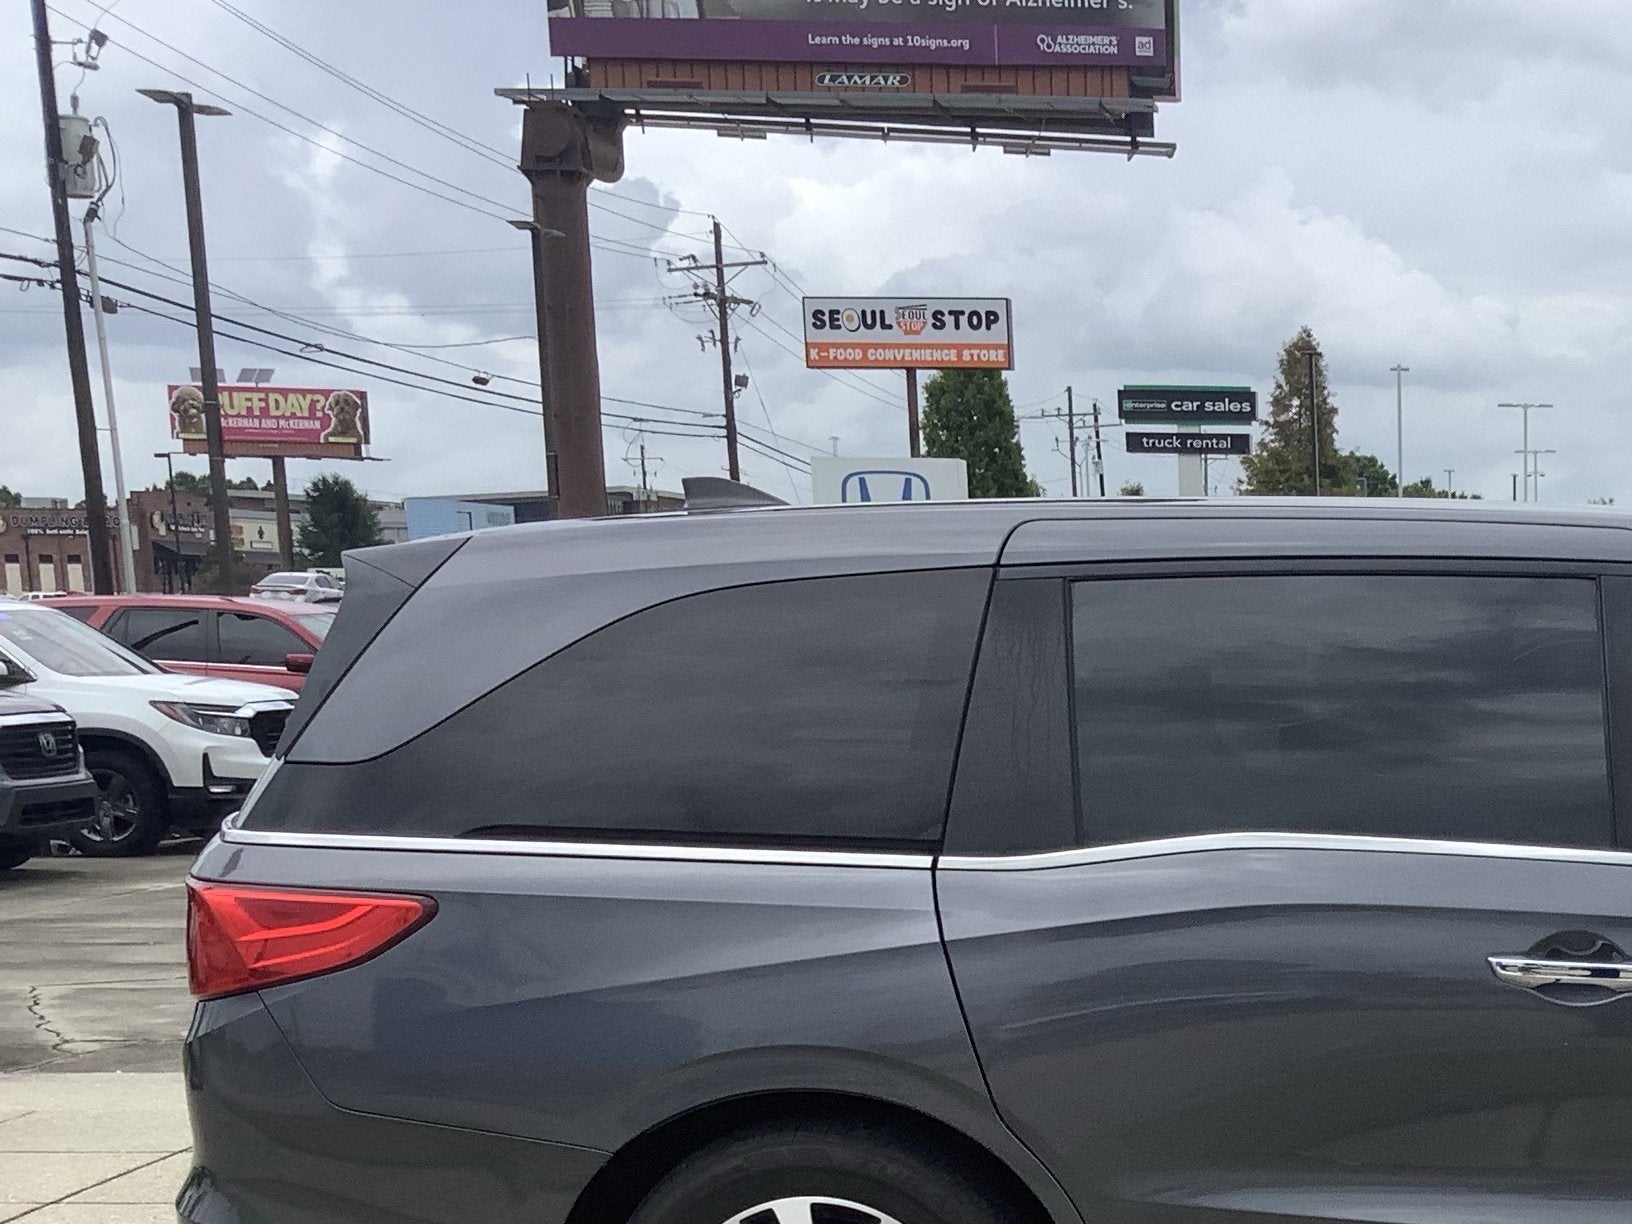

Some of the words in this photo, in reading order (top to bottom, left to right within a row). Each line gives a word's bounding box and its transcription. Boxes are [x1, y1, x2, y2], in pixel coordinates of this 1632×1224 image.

[808, 33, 839, 45] Learn
[841, 34, 860, 45] the
[862, 34, 890, 48] signs
[892, 35, 904, 46] at
[907, 35, 970, 50] 10signs.org
[1056, 35, 1118, 45] ALZHEIMER'S
[1137, 39, 1152, 49] ad
[1054, 44, 1118, 54] ASSOCIATION
[823, 74, 901, 86] LAMAR
[811, 307, 894, 332] SEOUL
[931, 309, 1000, 331] STOP
[901, 321, 924, 331] STOP
[809, 349, 862, 361] K-FOOD
[867, 349, 958, 361] CONVENIENCE
[962, 349, 1006, 362] STORE
[268, 392, 325, 417] DAY?
[1123, 400, 1167, 410] enterprise
[1171, 399, 1201, 412] car
[1204, 397, 1251, 412] sales
[261, 418, 278, 429] AND
[279, 418, 321, 429] McKERNAN
[1142, 436, 1181, 448] truck
[1187, 436, 1231, 449] rental
